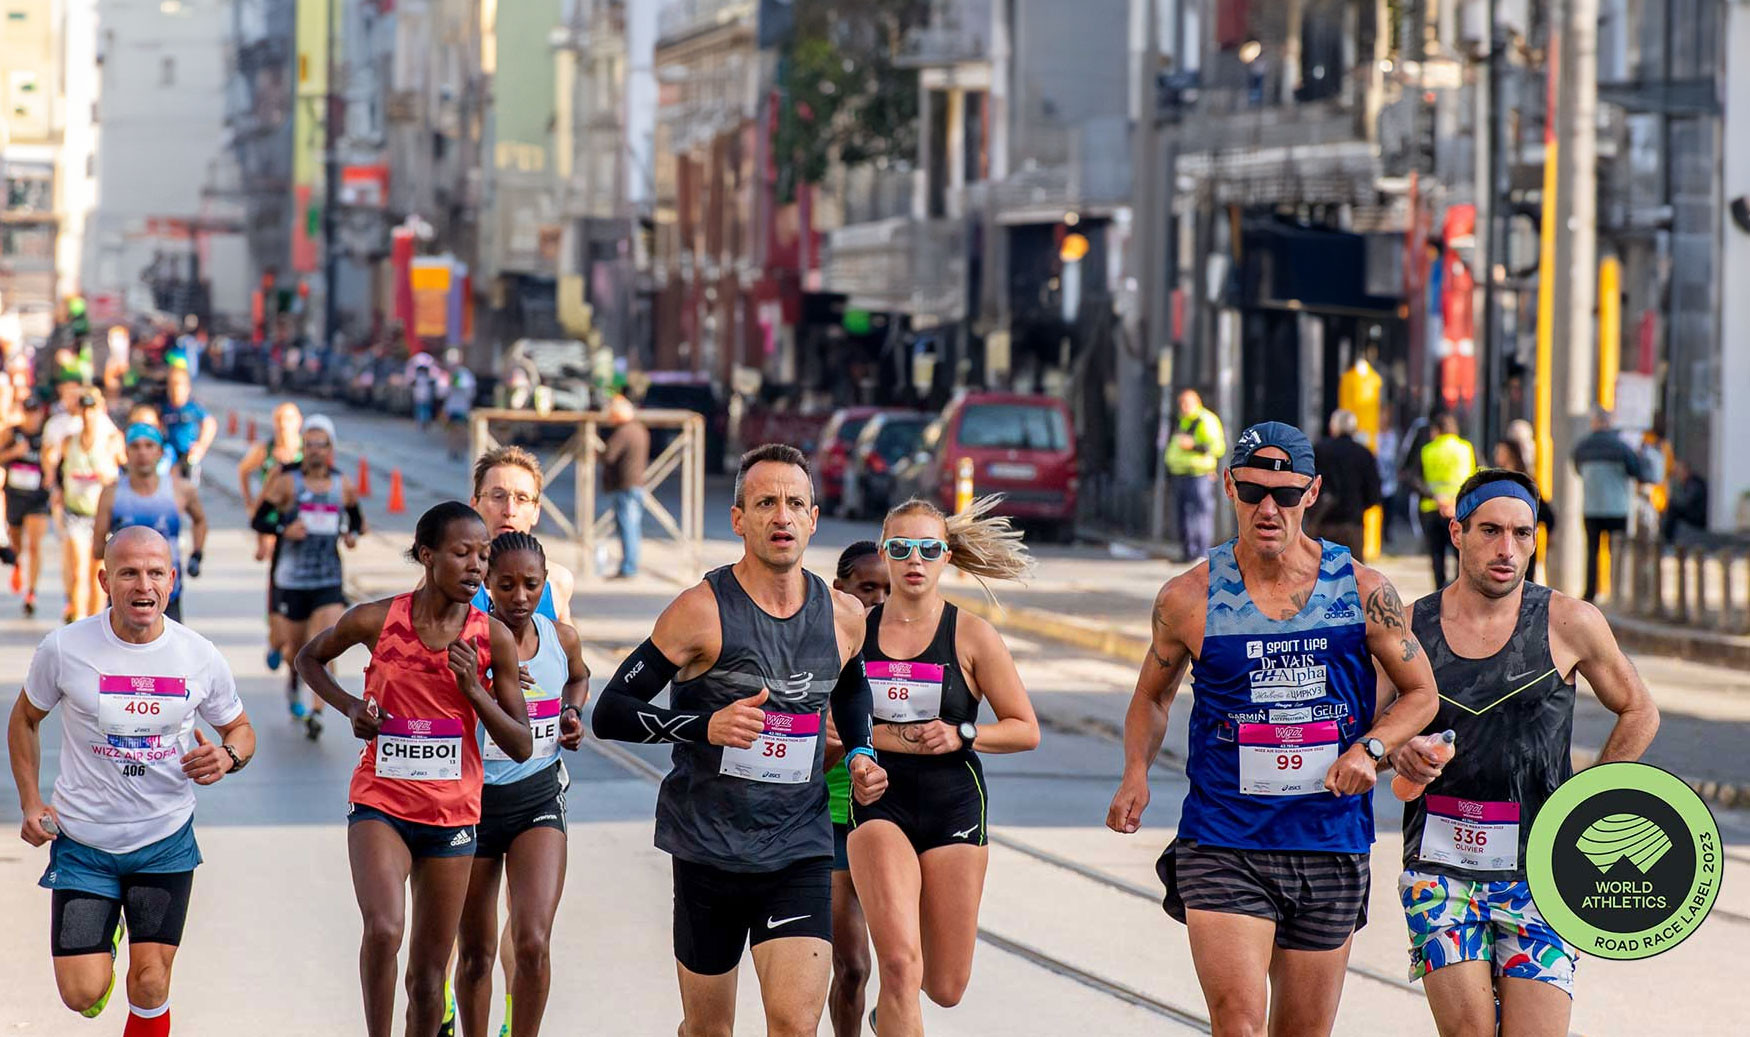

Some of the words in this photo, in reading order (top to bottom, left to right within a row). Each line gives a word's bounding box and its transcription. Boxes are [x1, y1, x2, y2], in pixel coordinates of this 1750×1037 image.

[1324, 610, 1355, 619] adidas
[1266, 640, 1300, 654] SPORT
[1261, 657, 1276, 670] Dr
[1281, 654, 1315, 668] VAIS
[1251, 667, 1325, 684] CH-Alpha
[888, 686, 909, 700] 68
[125, 701, 160, 715] 406
[1313, 703, 1348, 717] GELITA
[1228, 711, 1266, 721] GARMIN
[531, 724, 554, 739] LE
[91, 744, 121, 758] WIZZ
[124, 751, 143, 761] AIR
[382, 742, 456, 759] CHEBOI
[762, 741, 786, 758] 38
[1276, 755, 1303, 770] 99
[123, 765, 146, 777] 406
[450, 836, 472, 847] adidas
[1453, 827, 1487, 846] 336
[1455, 844, 1484, 853] OLIVIER
